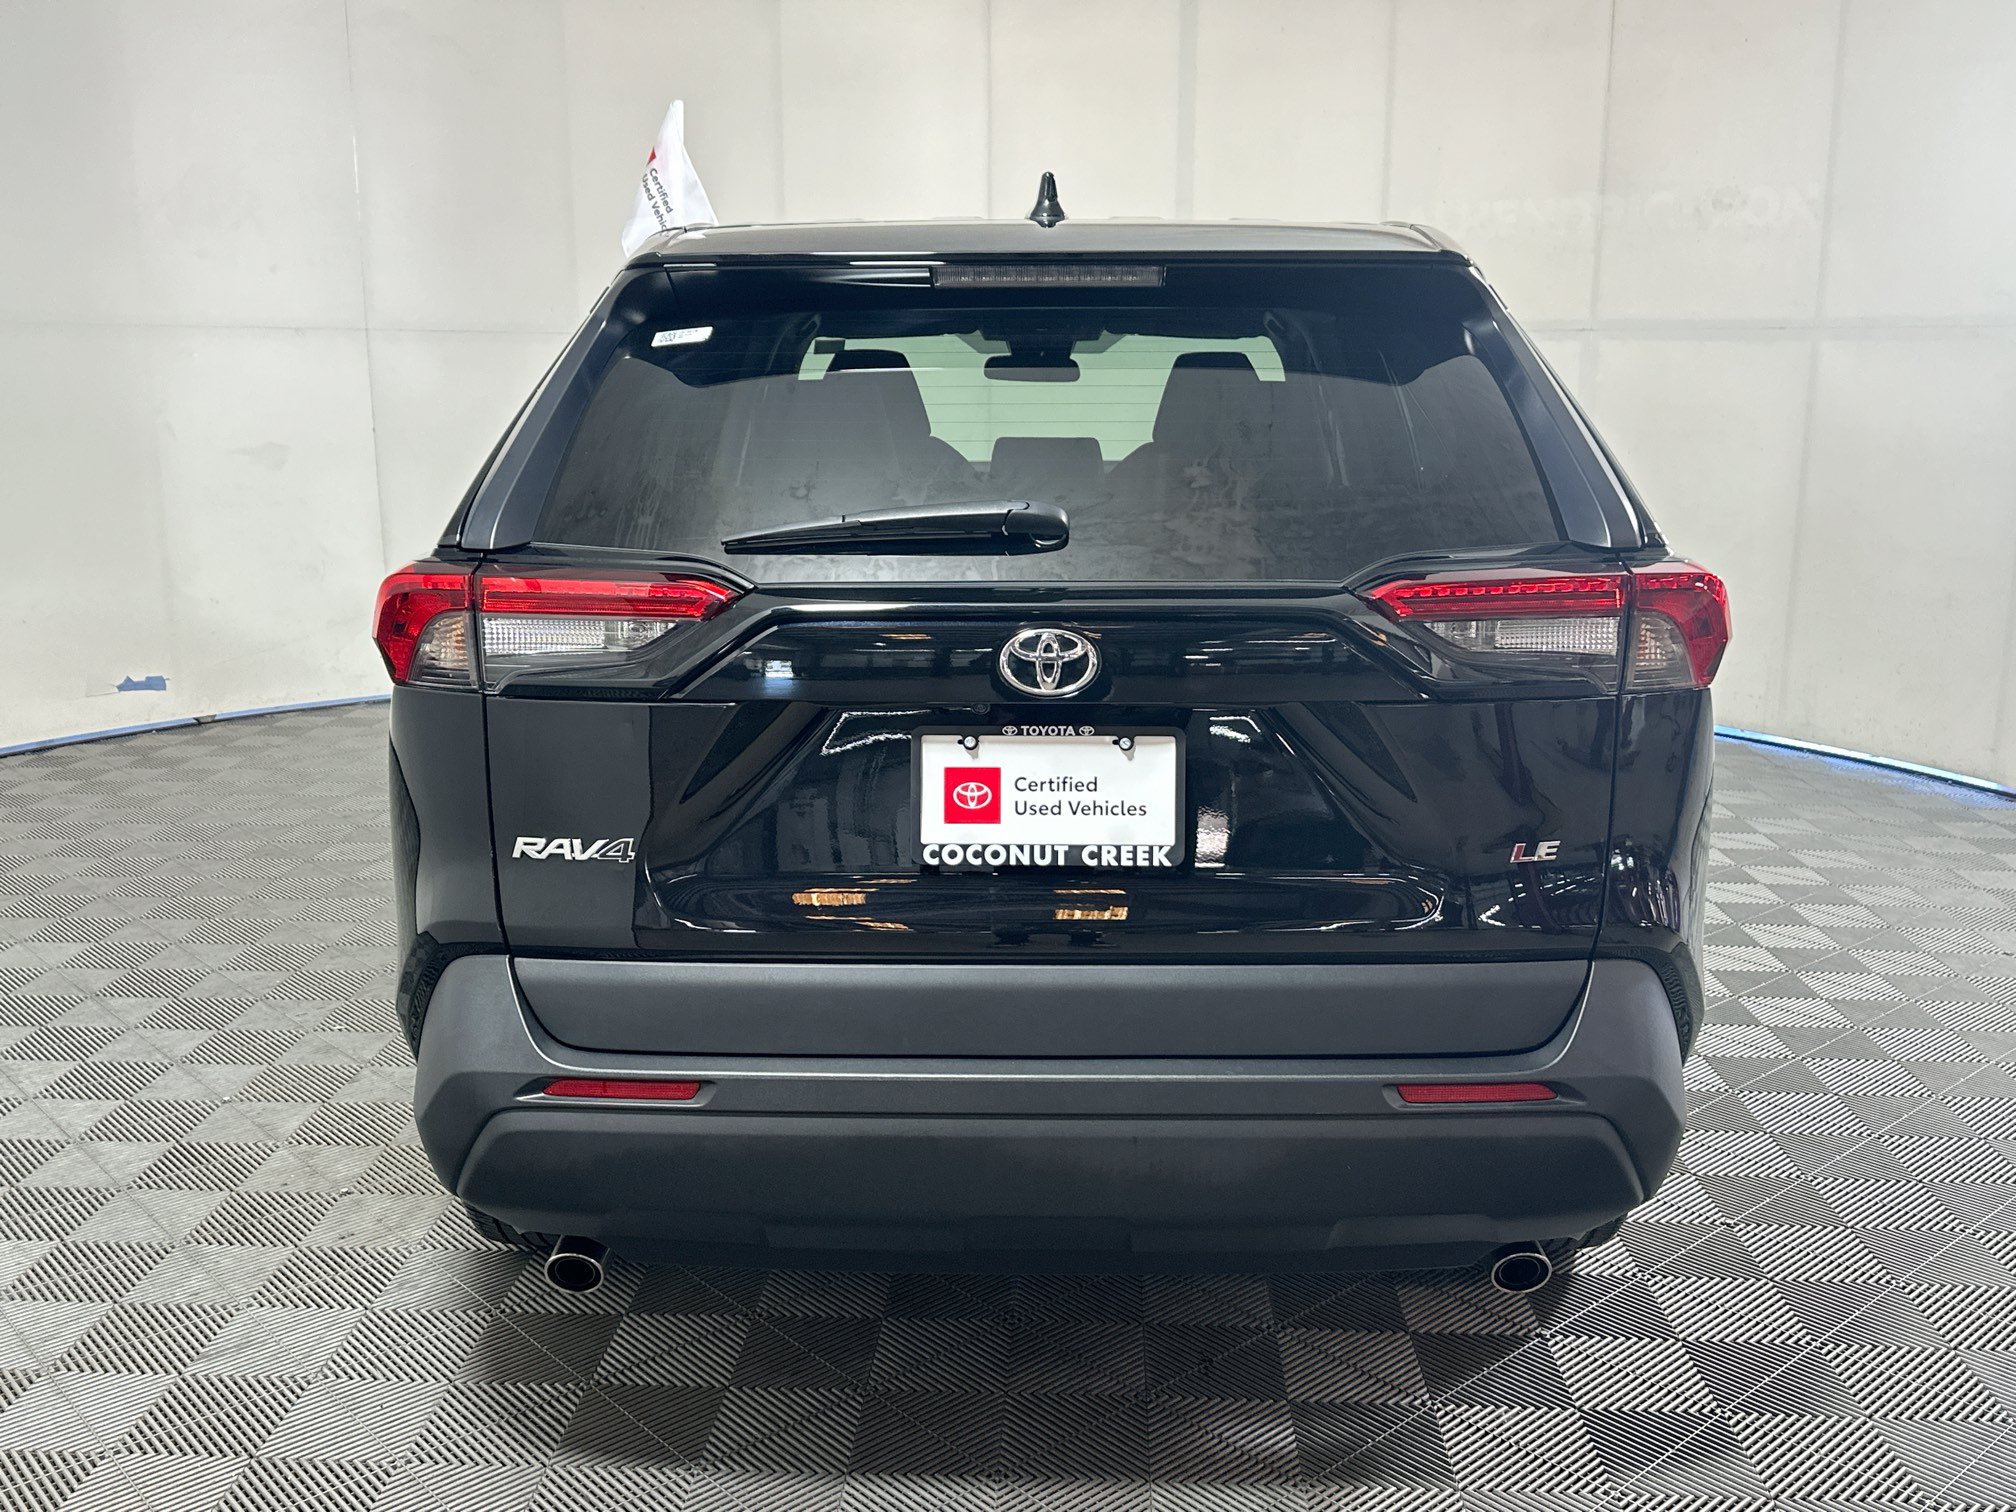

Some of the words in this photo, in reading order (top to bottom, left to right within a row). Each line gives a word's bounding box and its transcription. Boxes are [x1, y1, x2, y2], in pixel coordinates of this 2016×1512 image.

[642, 174, 656, 201] Used
[650, 168, 673, 214] Certified
[1020, 726, 1076, 736] TOYOTA
[1014, 776, 1098, 792] Certified
[1014, 801, 1062, 816] Used
[1068, 801, 1147, 816] Vehicles
[512, 836, 636, 863] RAV4
[922, 843, 1069, 866] COCONUT
[1081, 844, 1172, 867] CREEK
[1510, 840, 1561, 863] LE
